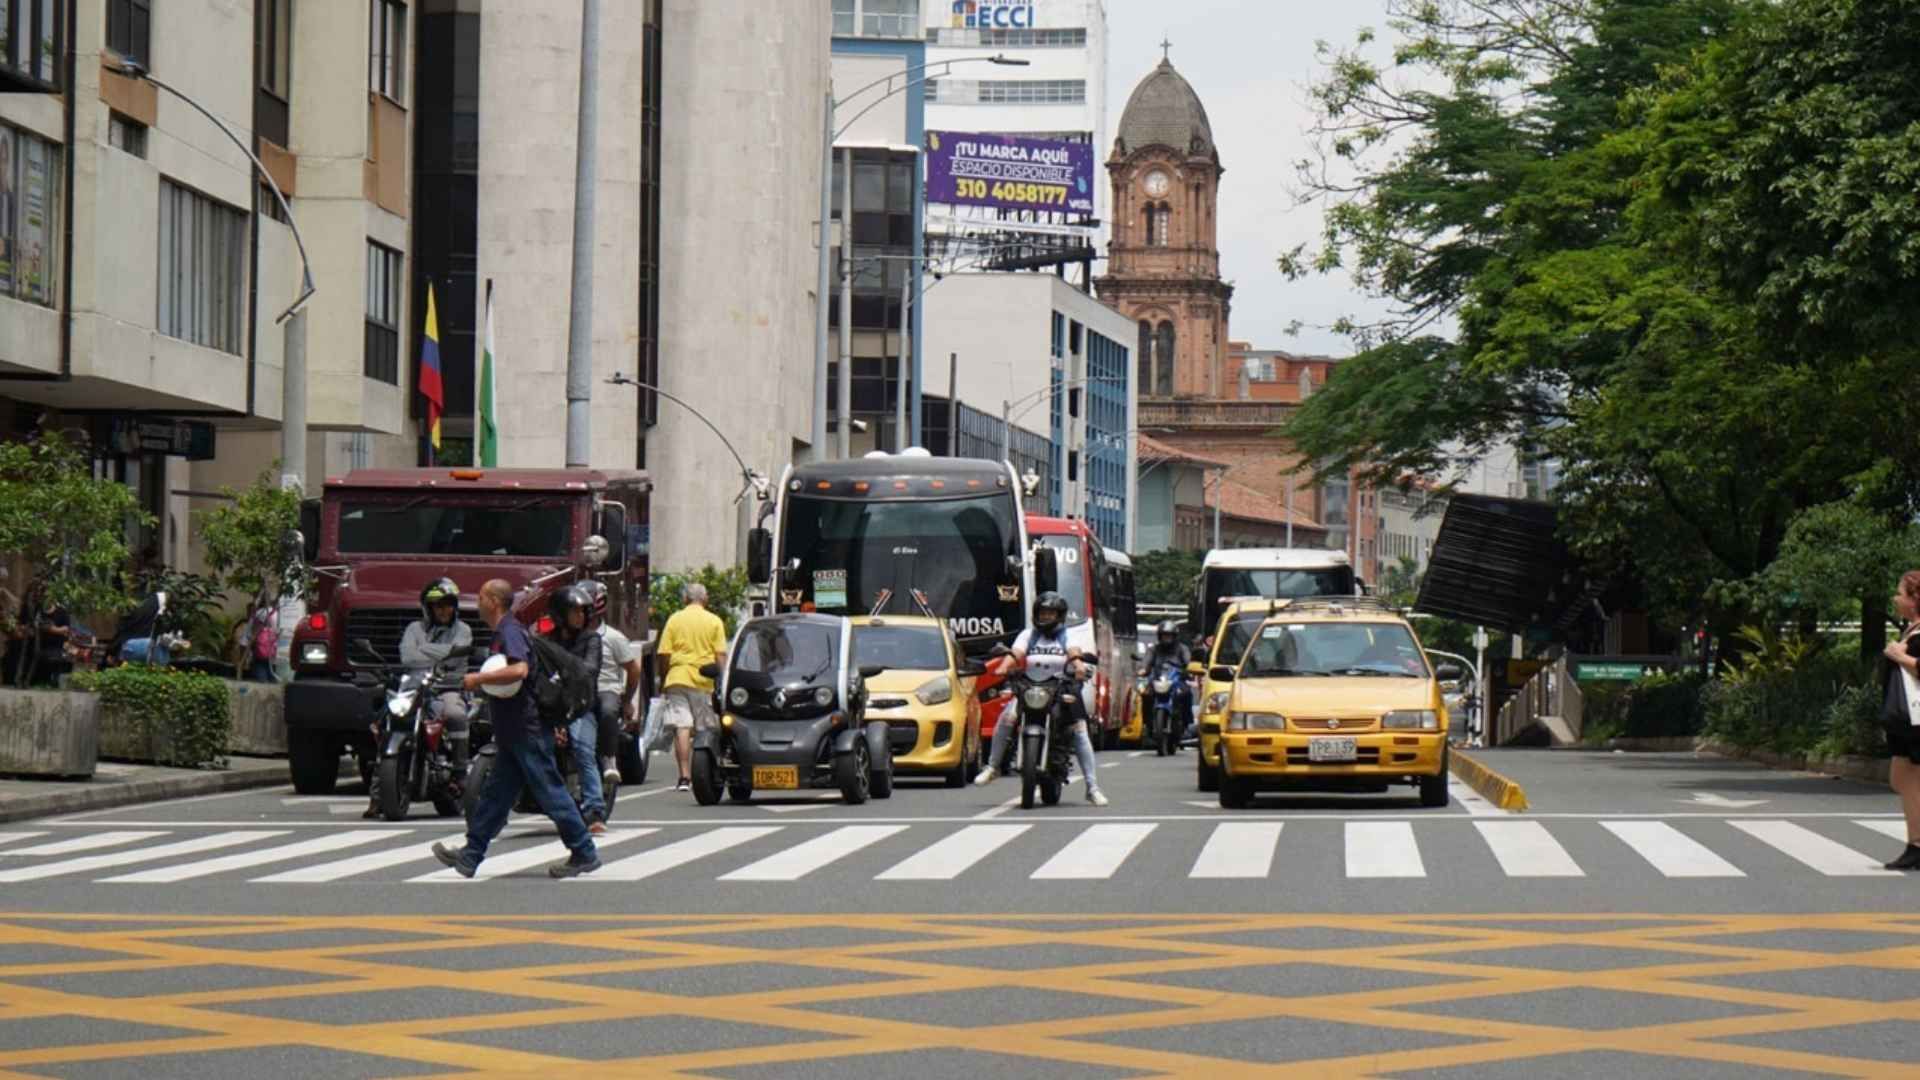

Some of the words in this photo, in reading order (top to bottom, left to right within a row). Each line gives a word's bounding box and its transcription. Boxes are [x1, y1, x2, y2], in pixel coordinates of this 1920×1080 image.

[979, 6, 1033, 27] ECCI
[980, 145, 1027, 161] MARCA
[1031, 147, 1069, 164] AQUÍ!
[951, 159, 1001, 177] ESPACIO
[1003, 163, 1073, 181] DISPONIBLE
[956, 178, 987, 199] 310
[991, 181, 1068, 205] 4058177
